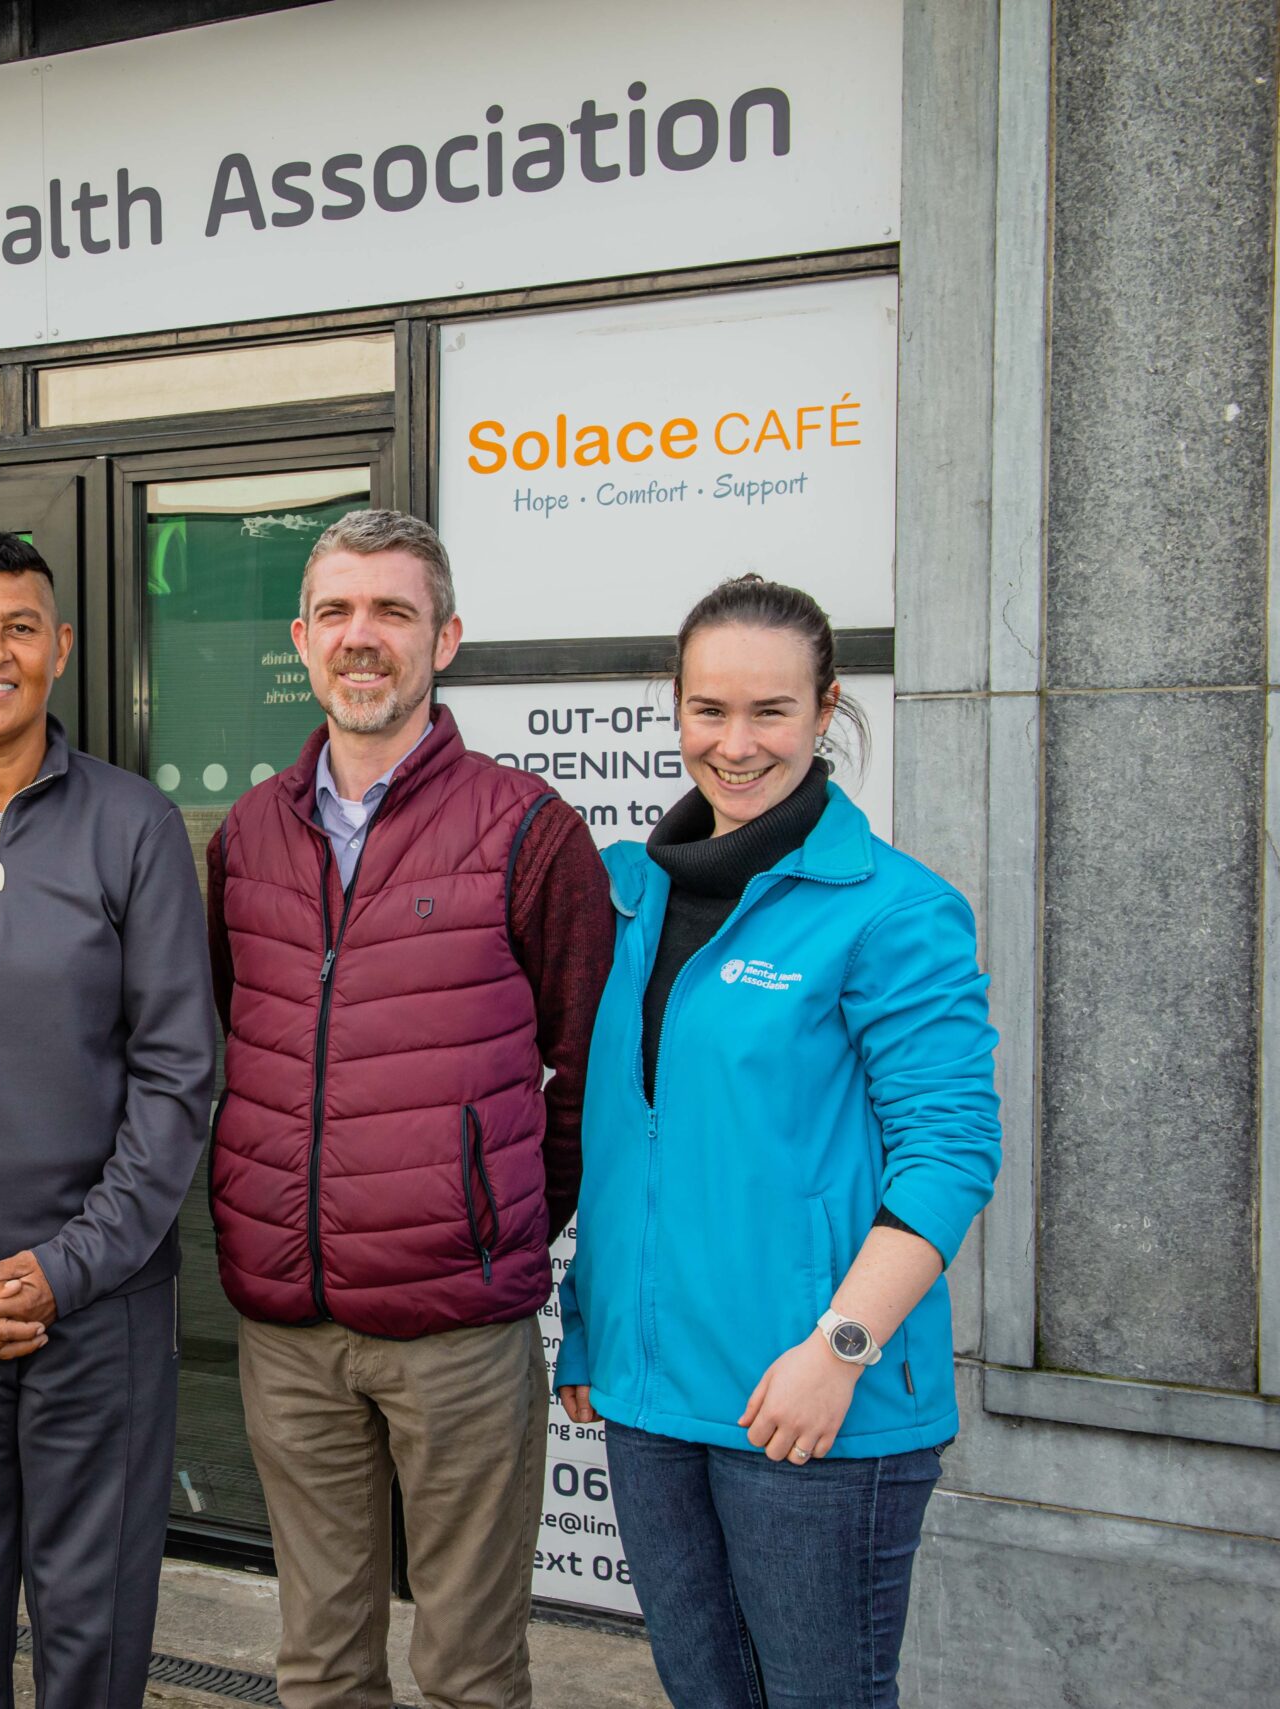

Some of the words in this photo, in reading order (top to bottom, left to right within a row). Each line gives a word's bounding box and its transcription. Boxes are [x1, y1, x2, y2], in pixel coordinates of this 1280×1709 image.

[205, 80, 791, 238] Association
[467, 414, 698, 475] Solace
[714, 392, 862, 455] CAFÉ
[513, 487, 569, 519] Hope
[596, 481, 688, 506] Comfort
[713, 472, 809, 506] Support
[528, 706, 681, 736] OUT-OF-
[628, 800, 664, 826] to
[540, 1511, 616, 1537] e@lim
